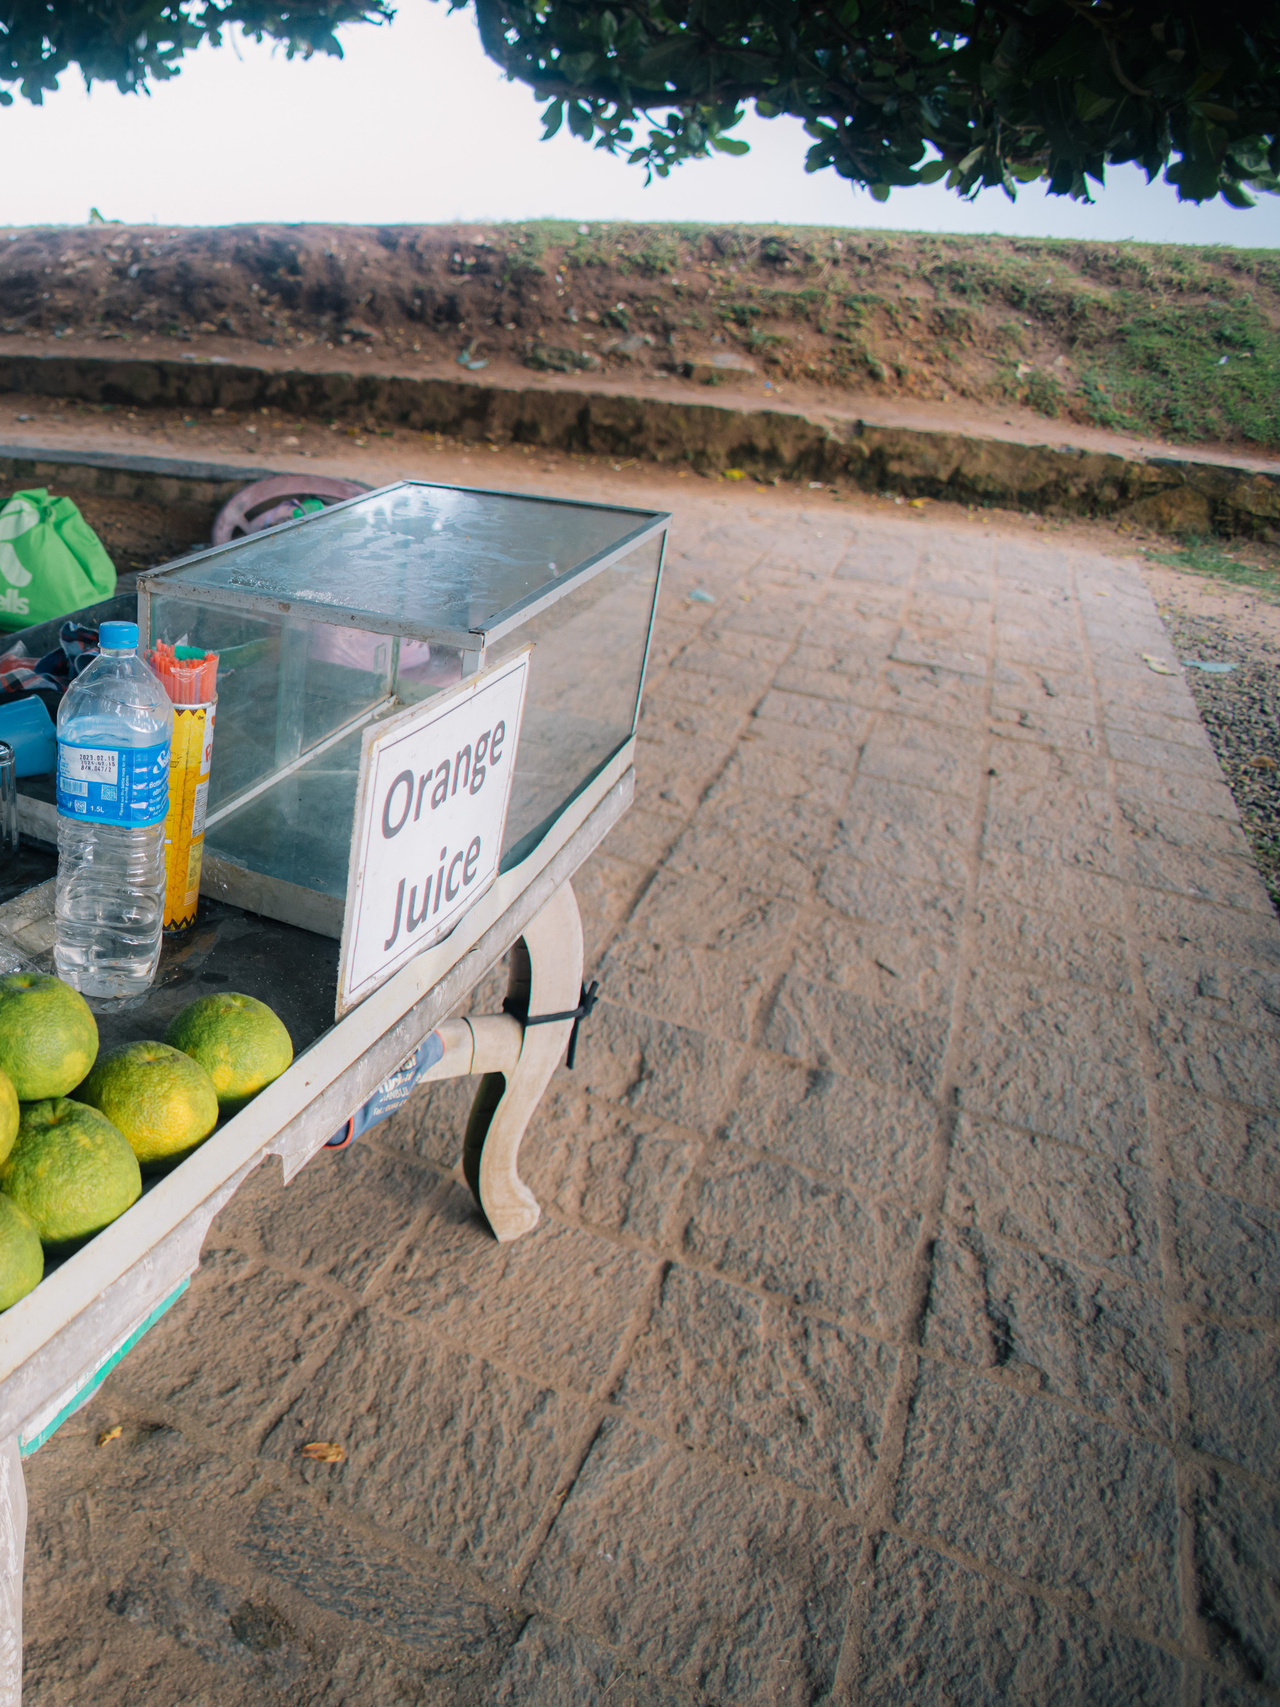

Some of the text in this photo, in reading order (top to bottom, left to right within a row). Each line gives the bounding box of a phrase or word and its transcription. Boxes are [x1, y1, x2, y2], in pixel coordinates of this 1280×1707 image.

[90, 805, 105, 813] 1.5L
[381, 720, 506, 839] Orange
[383, 835, 481, 951] Juice
